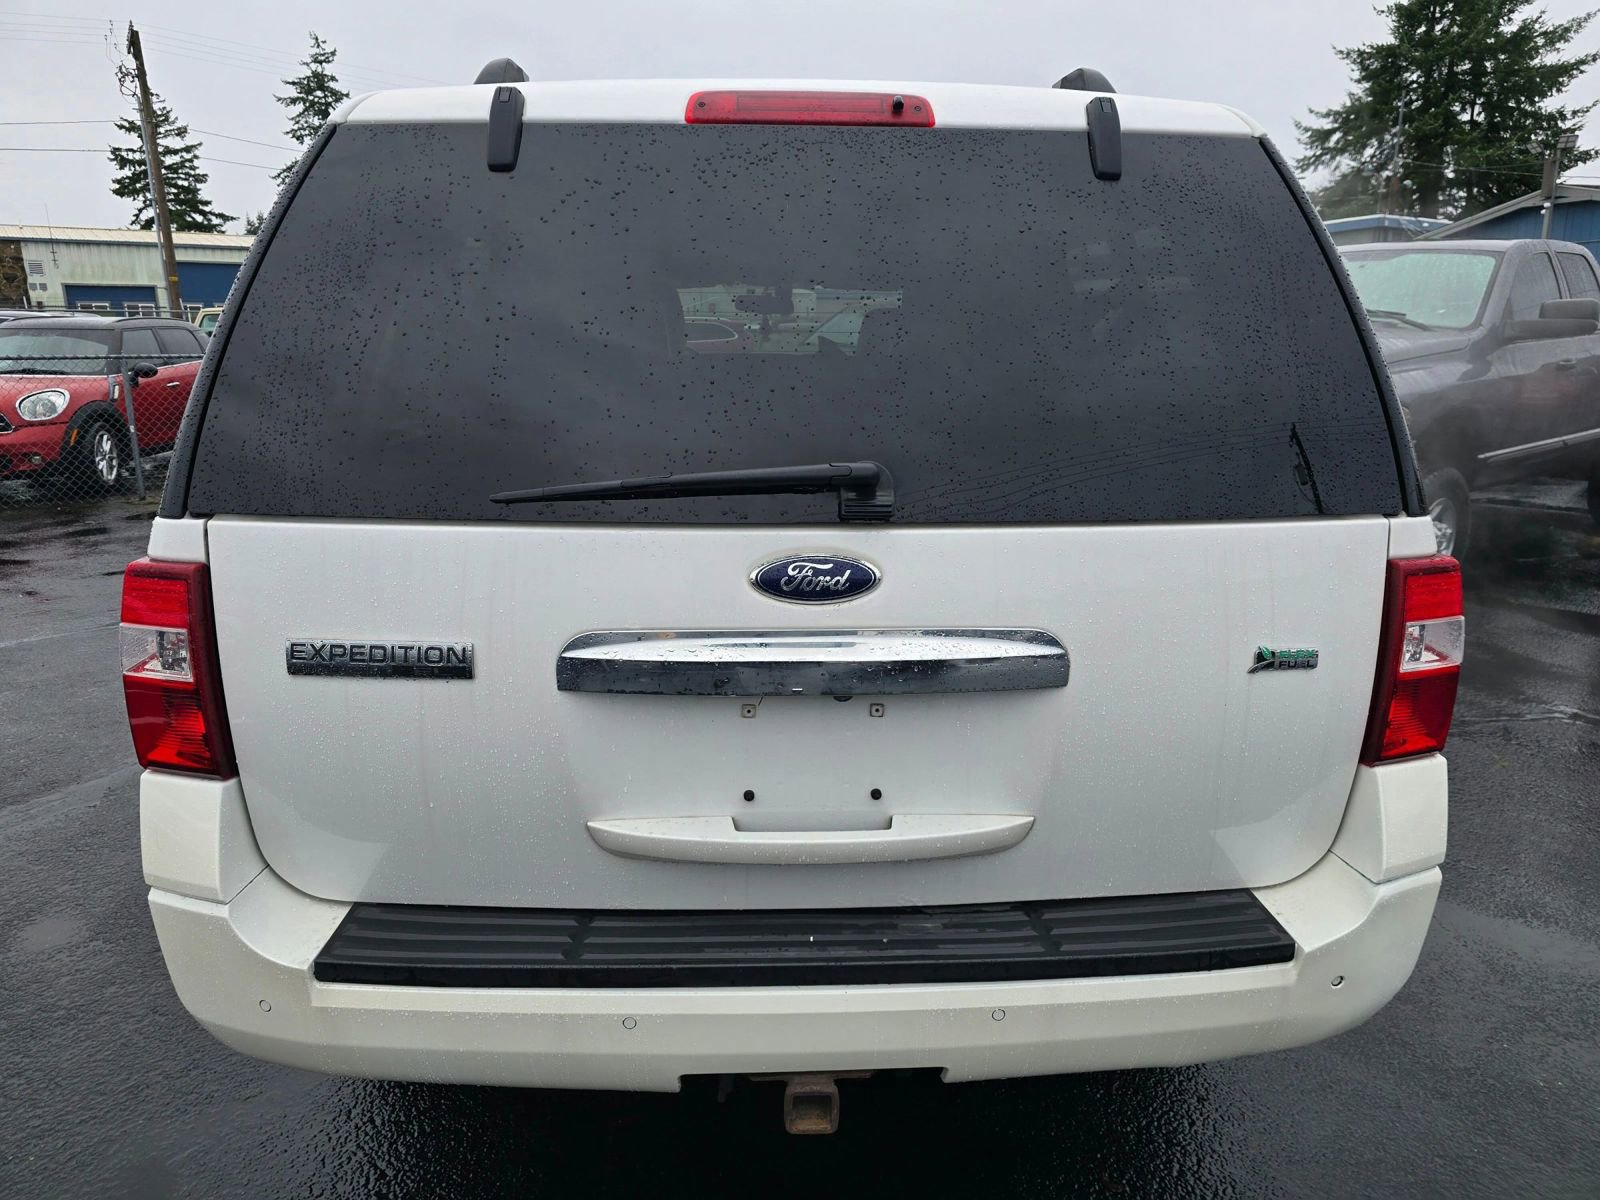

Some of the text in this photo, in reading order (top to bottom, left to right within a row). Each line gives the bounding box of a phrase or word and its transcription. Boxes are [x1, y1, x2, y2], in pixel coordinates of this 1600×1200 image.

[780, 562, 852, 591] Ford
[290, 643, 467, 665] EXPEDITION
[1278, 660, 1314, 668] FUEL
